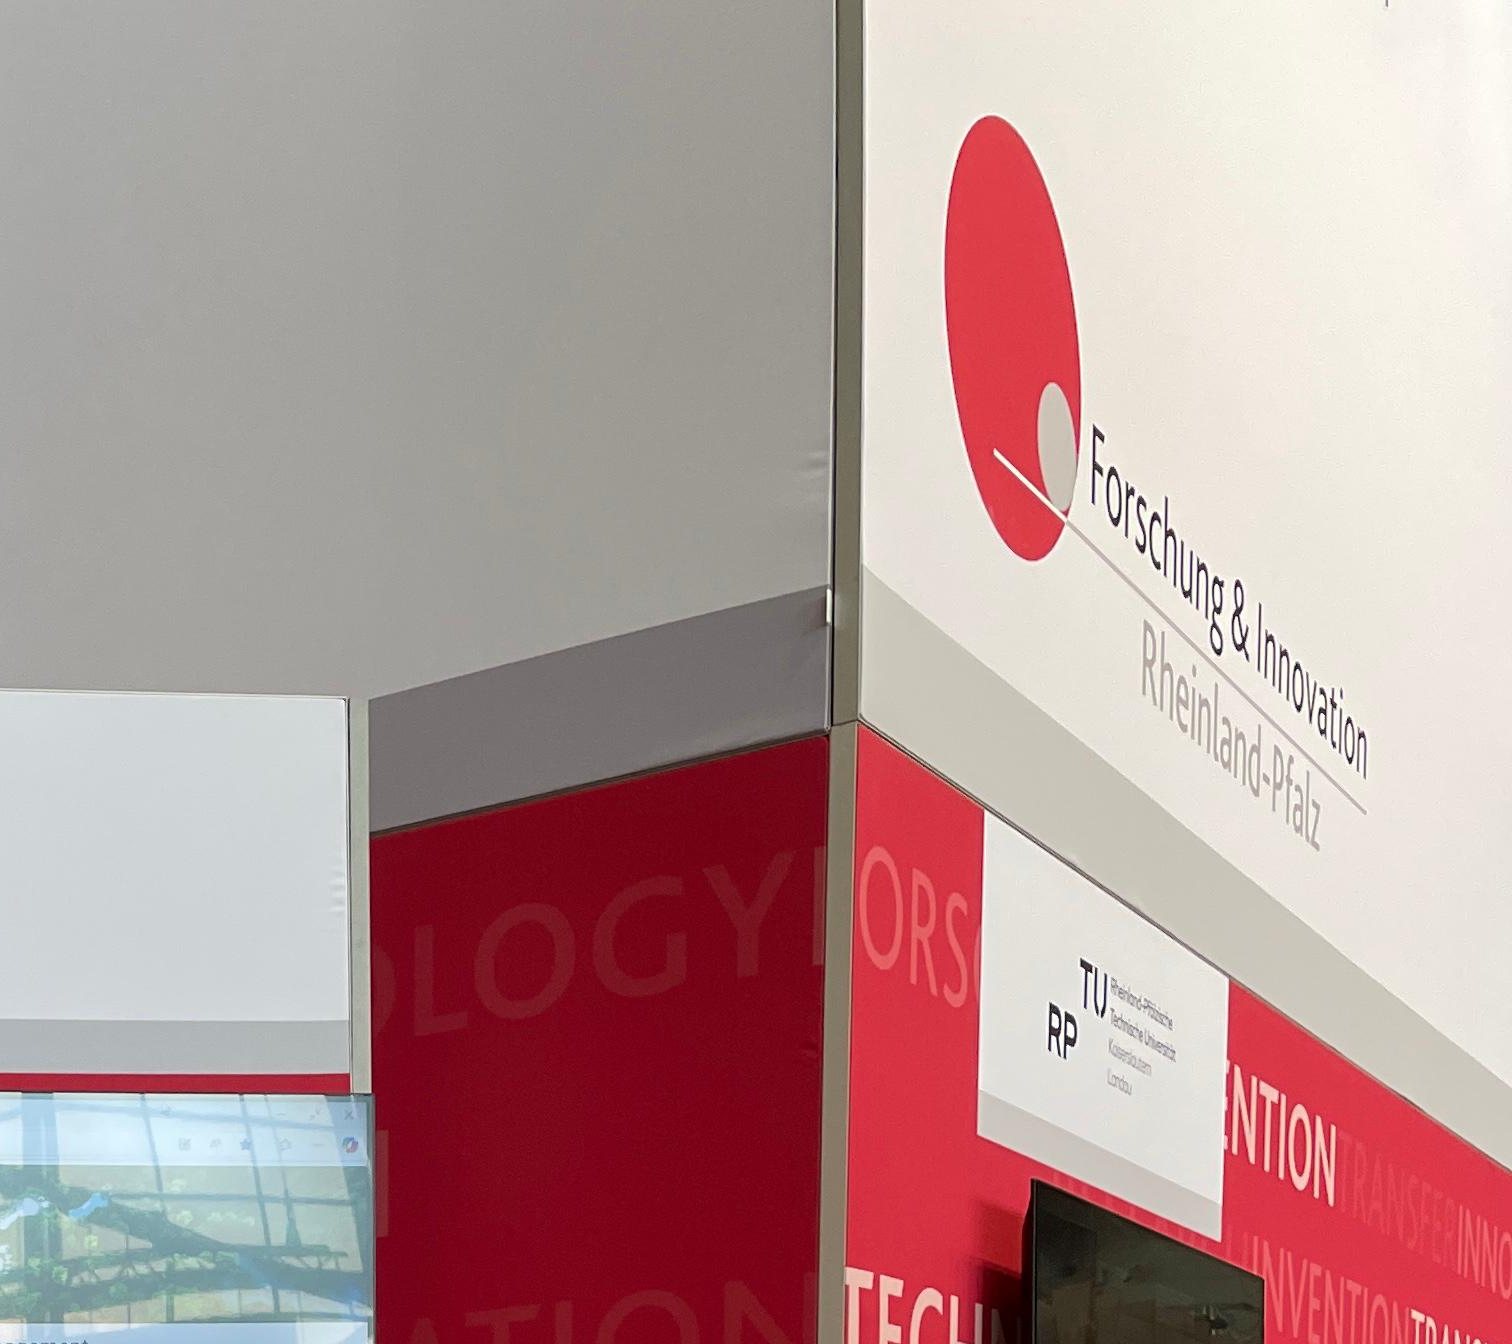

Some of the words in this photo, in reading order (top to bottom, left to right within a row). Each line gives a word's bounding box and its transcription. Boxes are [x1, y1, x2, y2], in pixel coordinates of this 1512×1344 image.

[1091, 424, 1225, 656] Forschung
[1229, 579, 1251, 660] &
[1257, 601, 1369, 781] Innovation
[1141, 619, 1322, 852] Rheinland-Pfalz
[372, 847, 796, 1038] LOGY
[1048, 1001, 1078, 1060] RP
[1080, 957, 1108, 1018] TU
